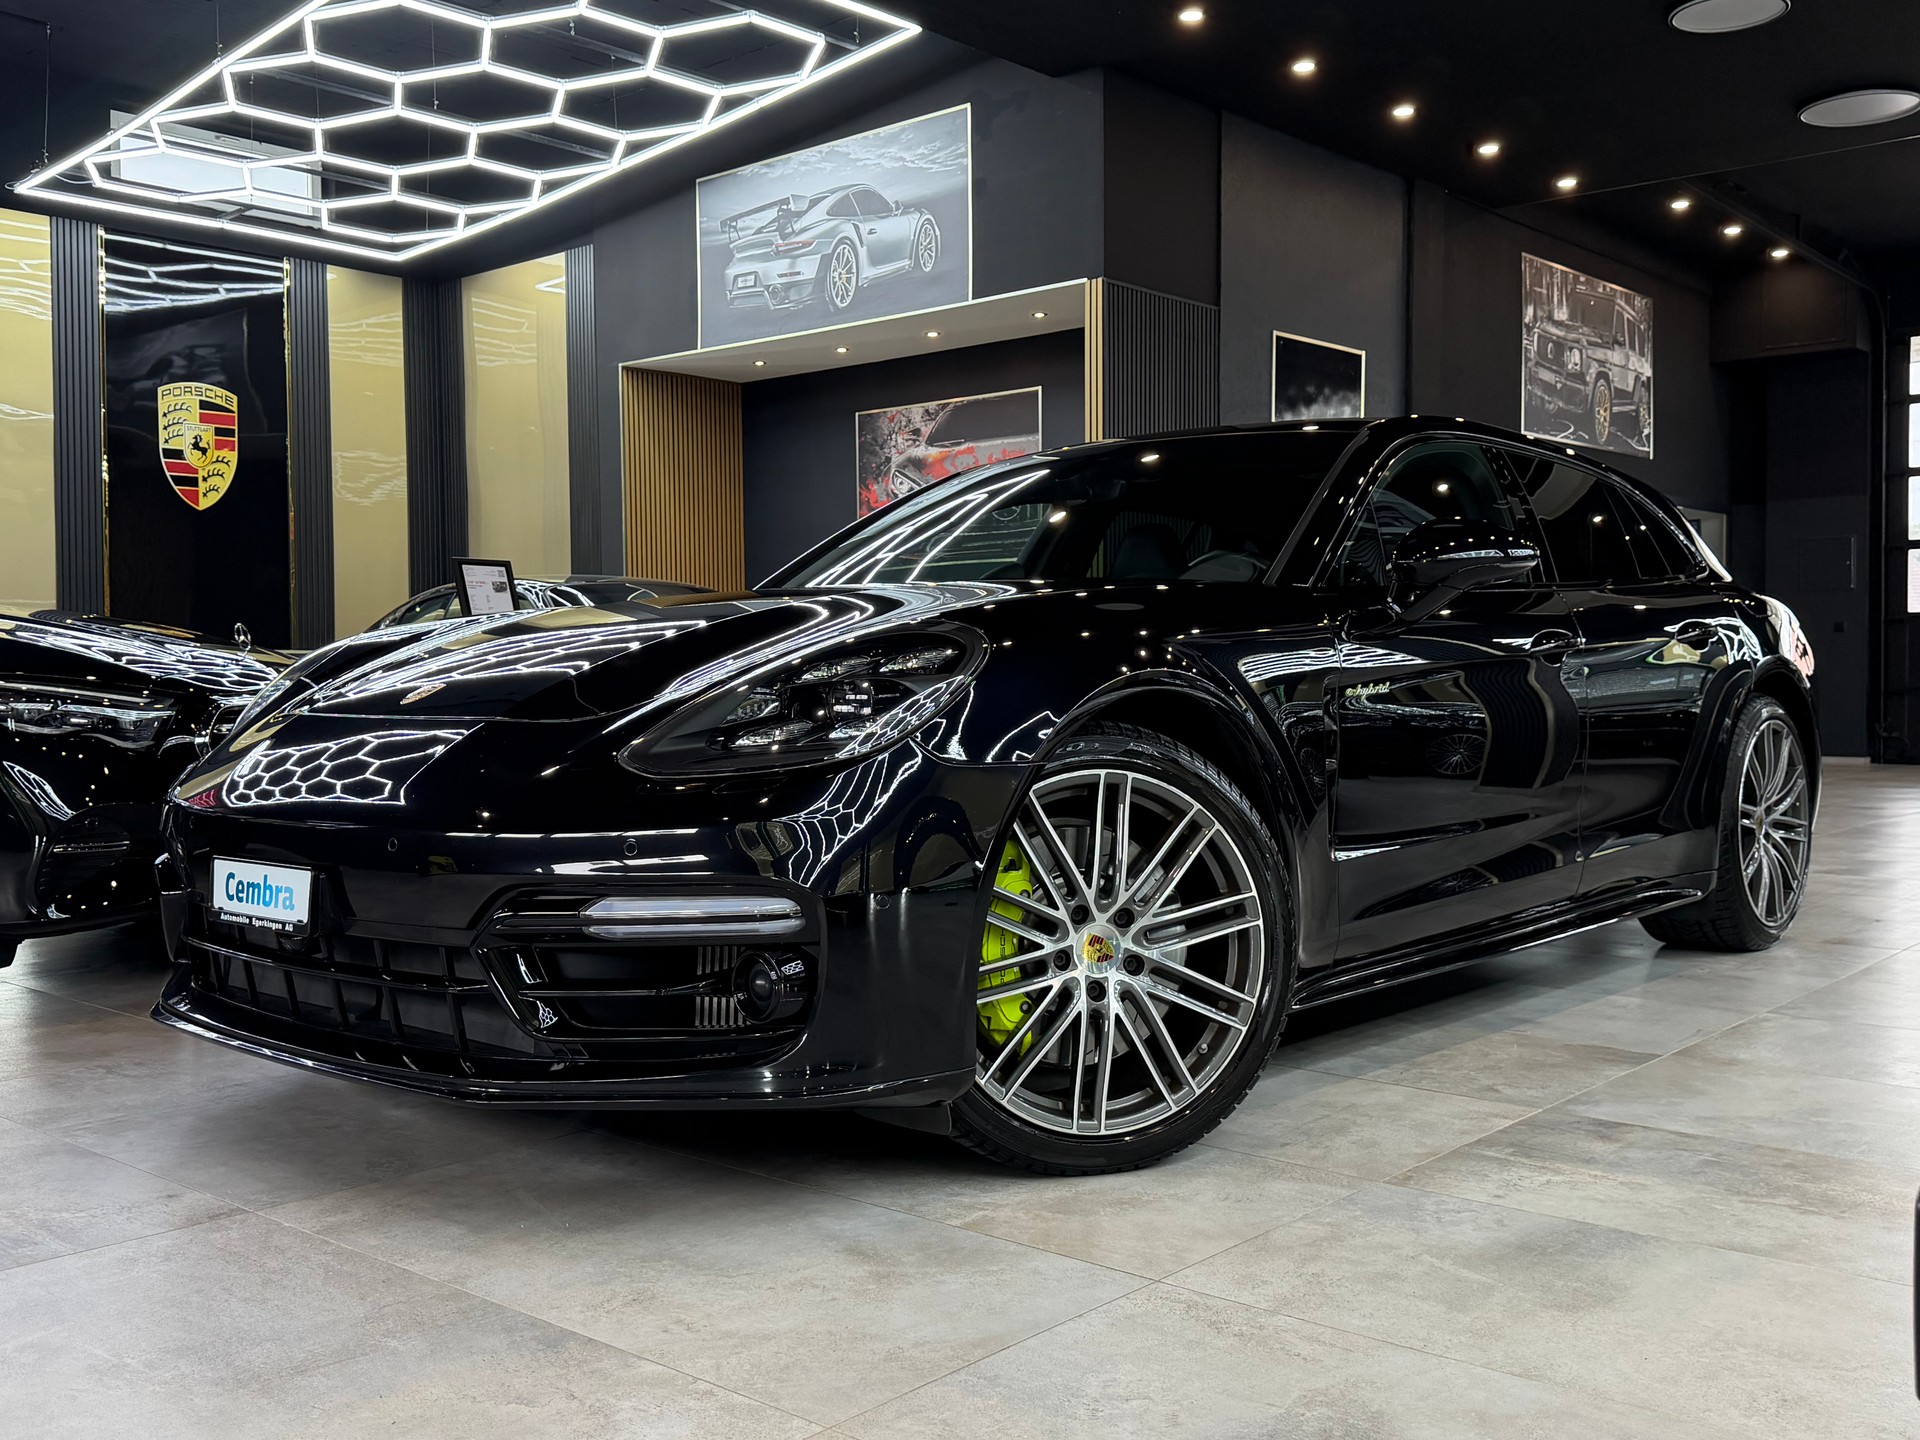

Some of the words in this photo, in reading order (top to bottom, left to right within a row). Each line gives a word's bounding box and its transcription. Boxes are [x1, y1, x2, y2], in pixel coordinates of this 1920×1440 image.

[161, 385, 235, 408] PORSCHE
[186, 425, 211, 433] STUTTGART
[225, 871, 295, 911] Cembra
[220, 912, 250, 924] Automobile
[252, 917, 282, 931] Egerkingen
[284, 923, 294, 932] AG
